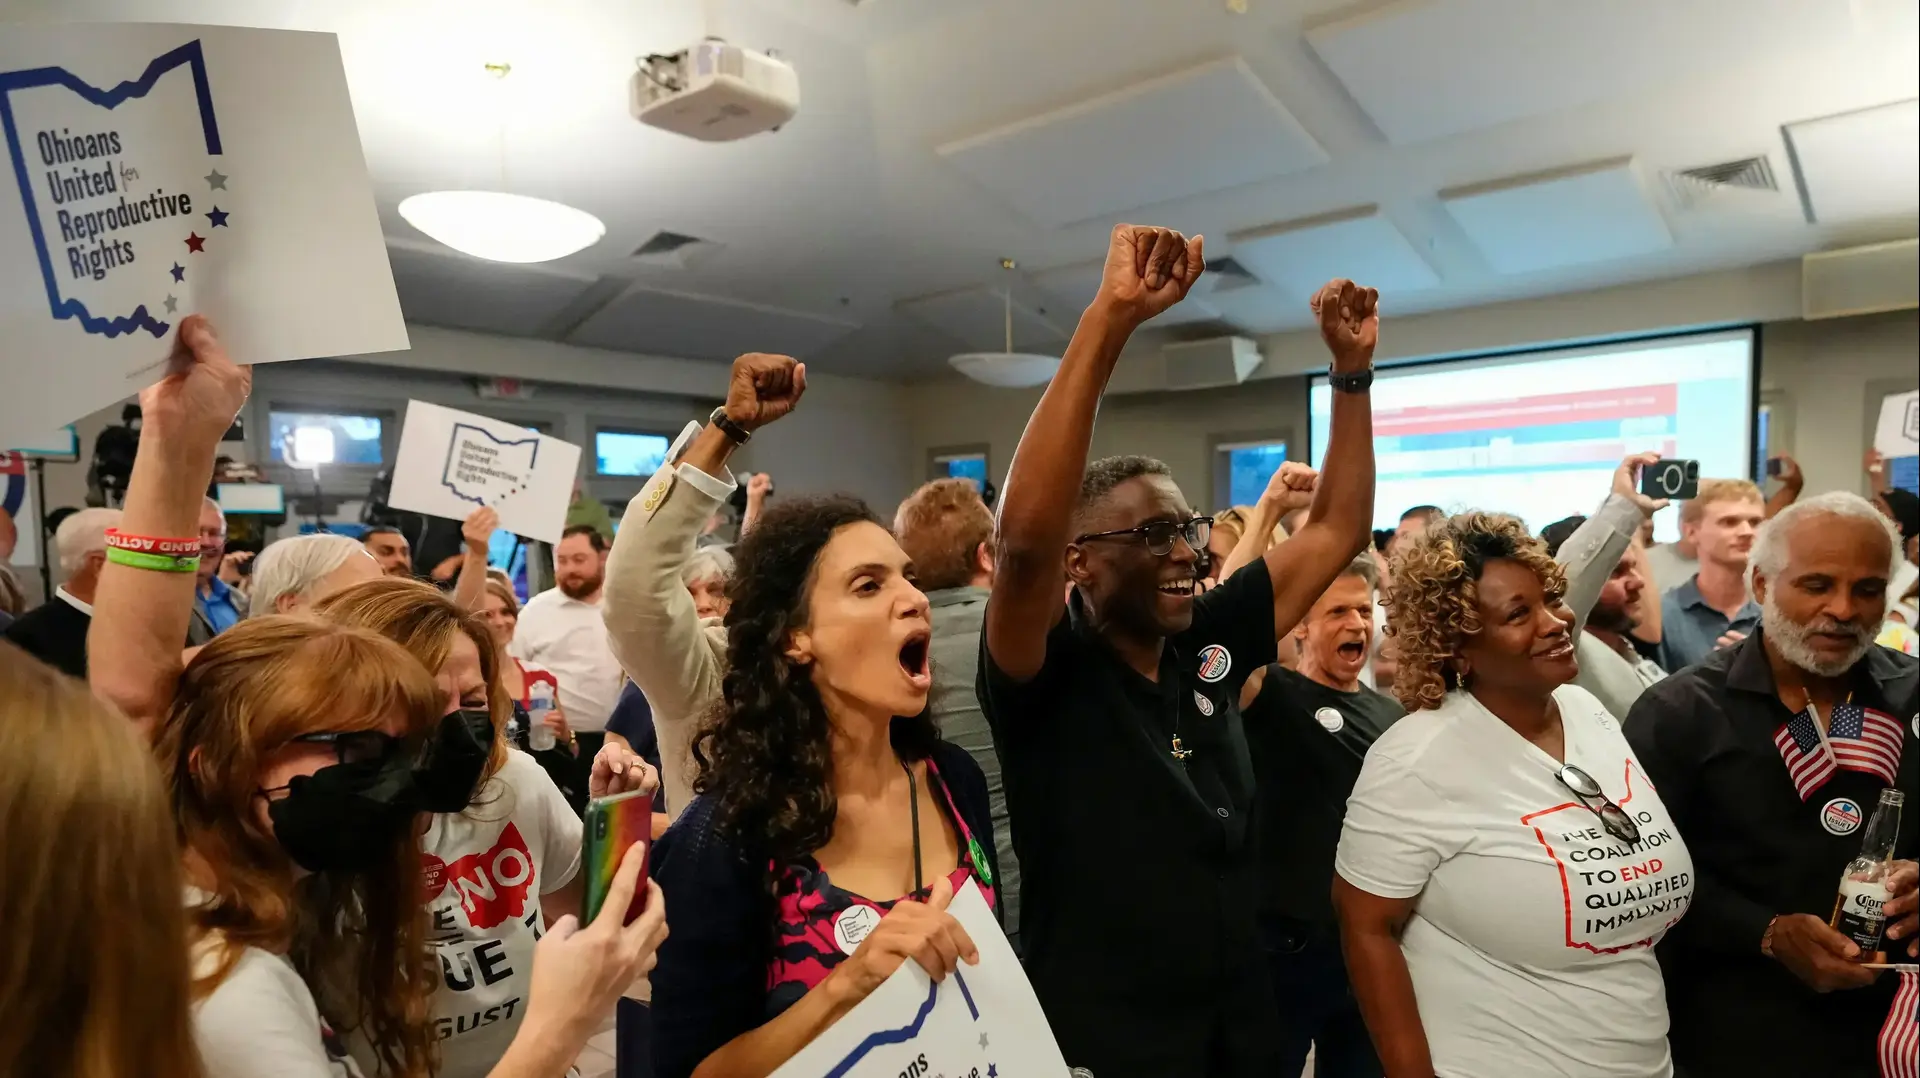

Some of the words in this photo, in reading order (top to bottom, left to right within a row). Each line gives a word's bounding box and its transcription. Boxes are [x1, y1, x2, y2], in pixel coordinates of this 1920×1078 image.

[37, 128, 122, 166] Ohioans
[47, 161, 117, 204] United
[119, 161, 140, 192] for
[57, 188, 192, 244] Reproductive
[67, 239, 135, 280] Rights
[1632, 811, 1652, 827] IO
[1829, 816, 1846, 827] ISSUE
[1569, 829, 1672, 862] COALITION
[457, 848, 530, 913] NO
[1580, 870, 1616, 886] TO
[1620, 858, 1663, 882] END
[1585, 872, 1690, 909] QUALIFIED
[1585, 890, 1692, 933] IMMUNITY
[430, 997, 520, 1041] GUST
